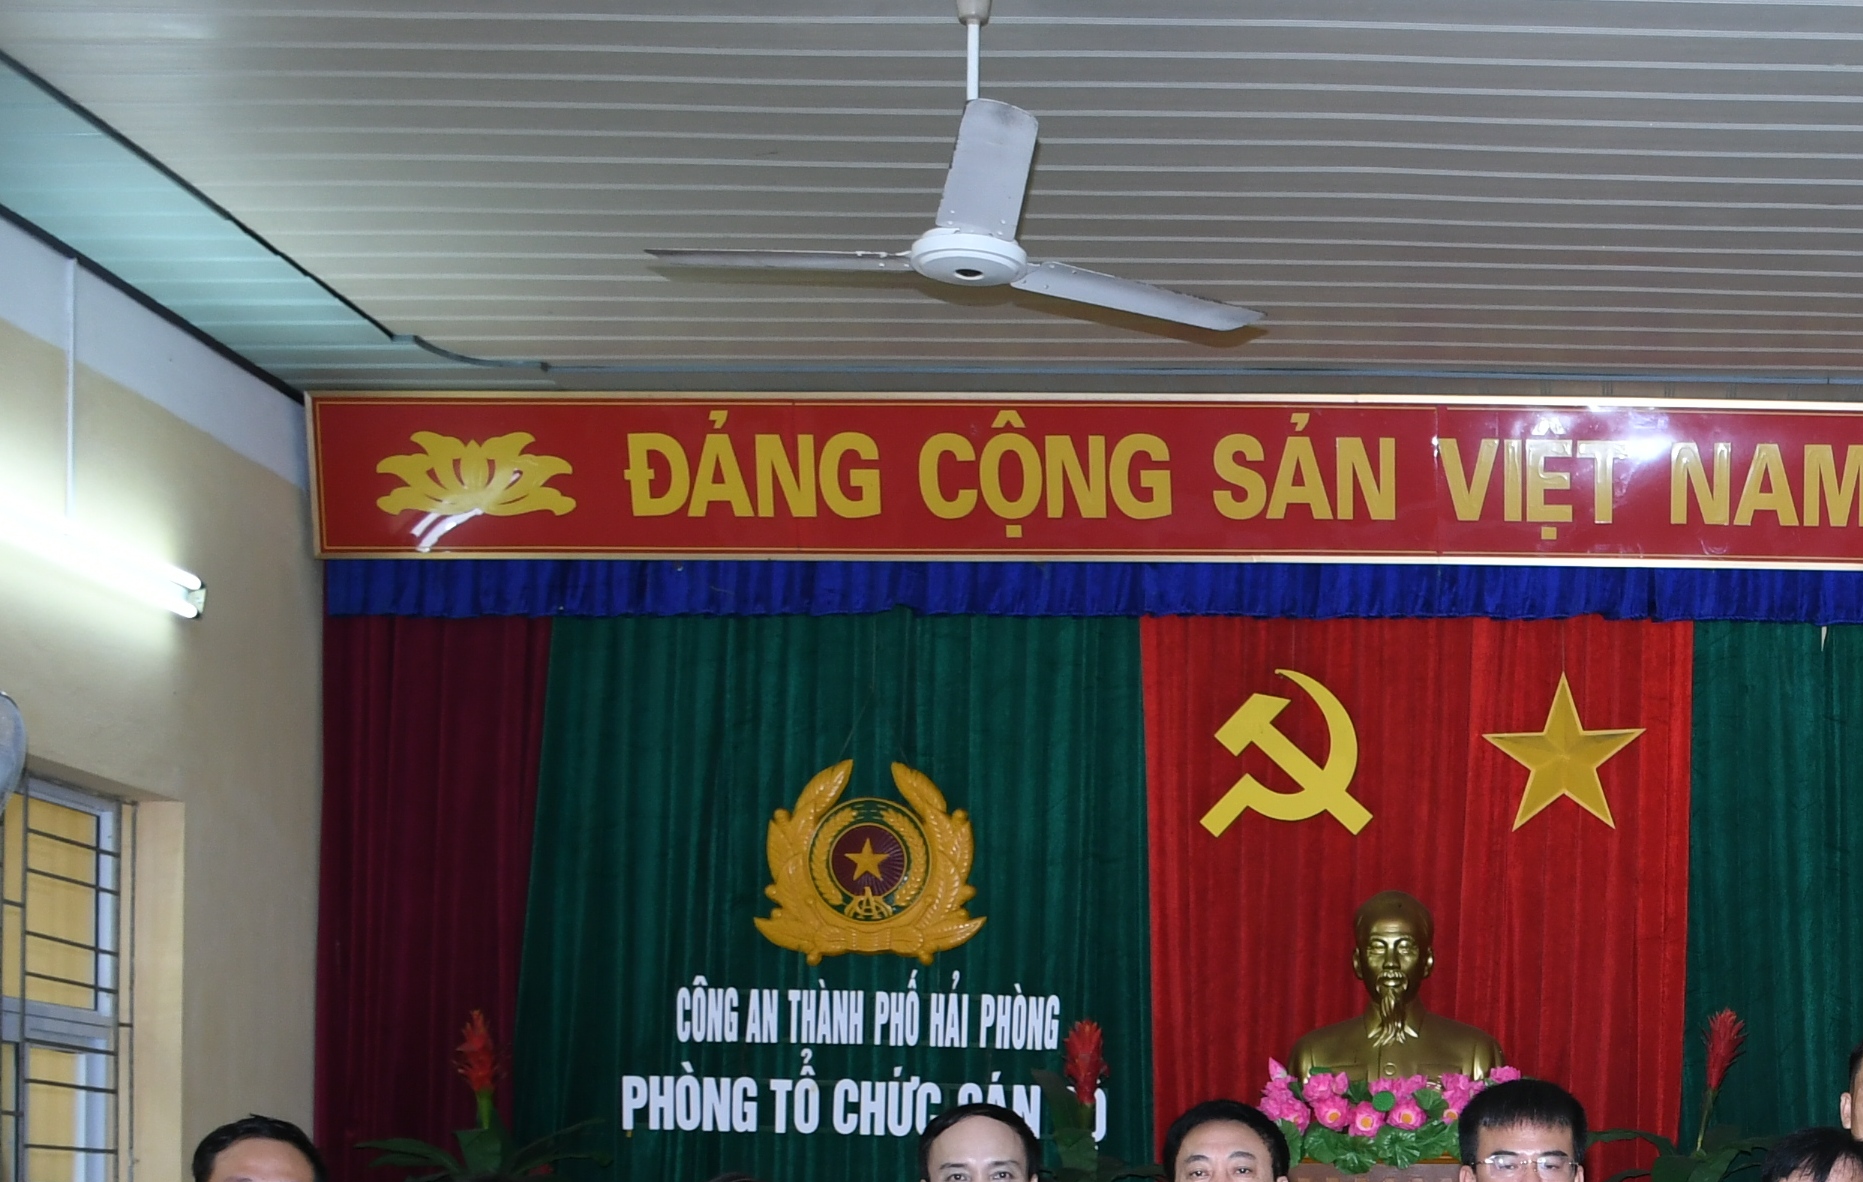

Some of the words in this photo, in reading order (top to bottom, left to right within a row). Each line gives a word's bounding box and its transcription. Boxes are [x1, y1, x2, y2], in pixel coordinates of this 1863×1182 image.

[623, 410, 881, 518] ĐẢNG
[918, 409, 1172, 538] CỘNG
[1213, 413, 1396, 522] SẢN
[1440, 417, 1626, 540] VIỆT
[676, 975, 738, 1043] CÔNG
[745, 988, 778, 1043] AN
[788, 978, 864, 1045] THÀNH
[874, 969, 919, 1046] PHỐ
[929, 970, 969, 1048] HẢI
[979, 984, 1060, 1051] PHÒNG
[621, 1061, 758, 1133] PHÒNG
[770, 1049, 820, 1134] TỔ
[833, 1065, 942, 1137] CHỨC
